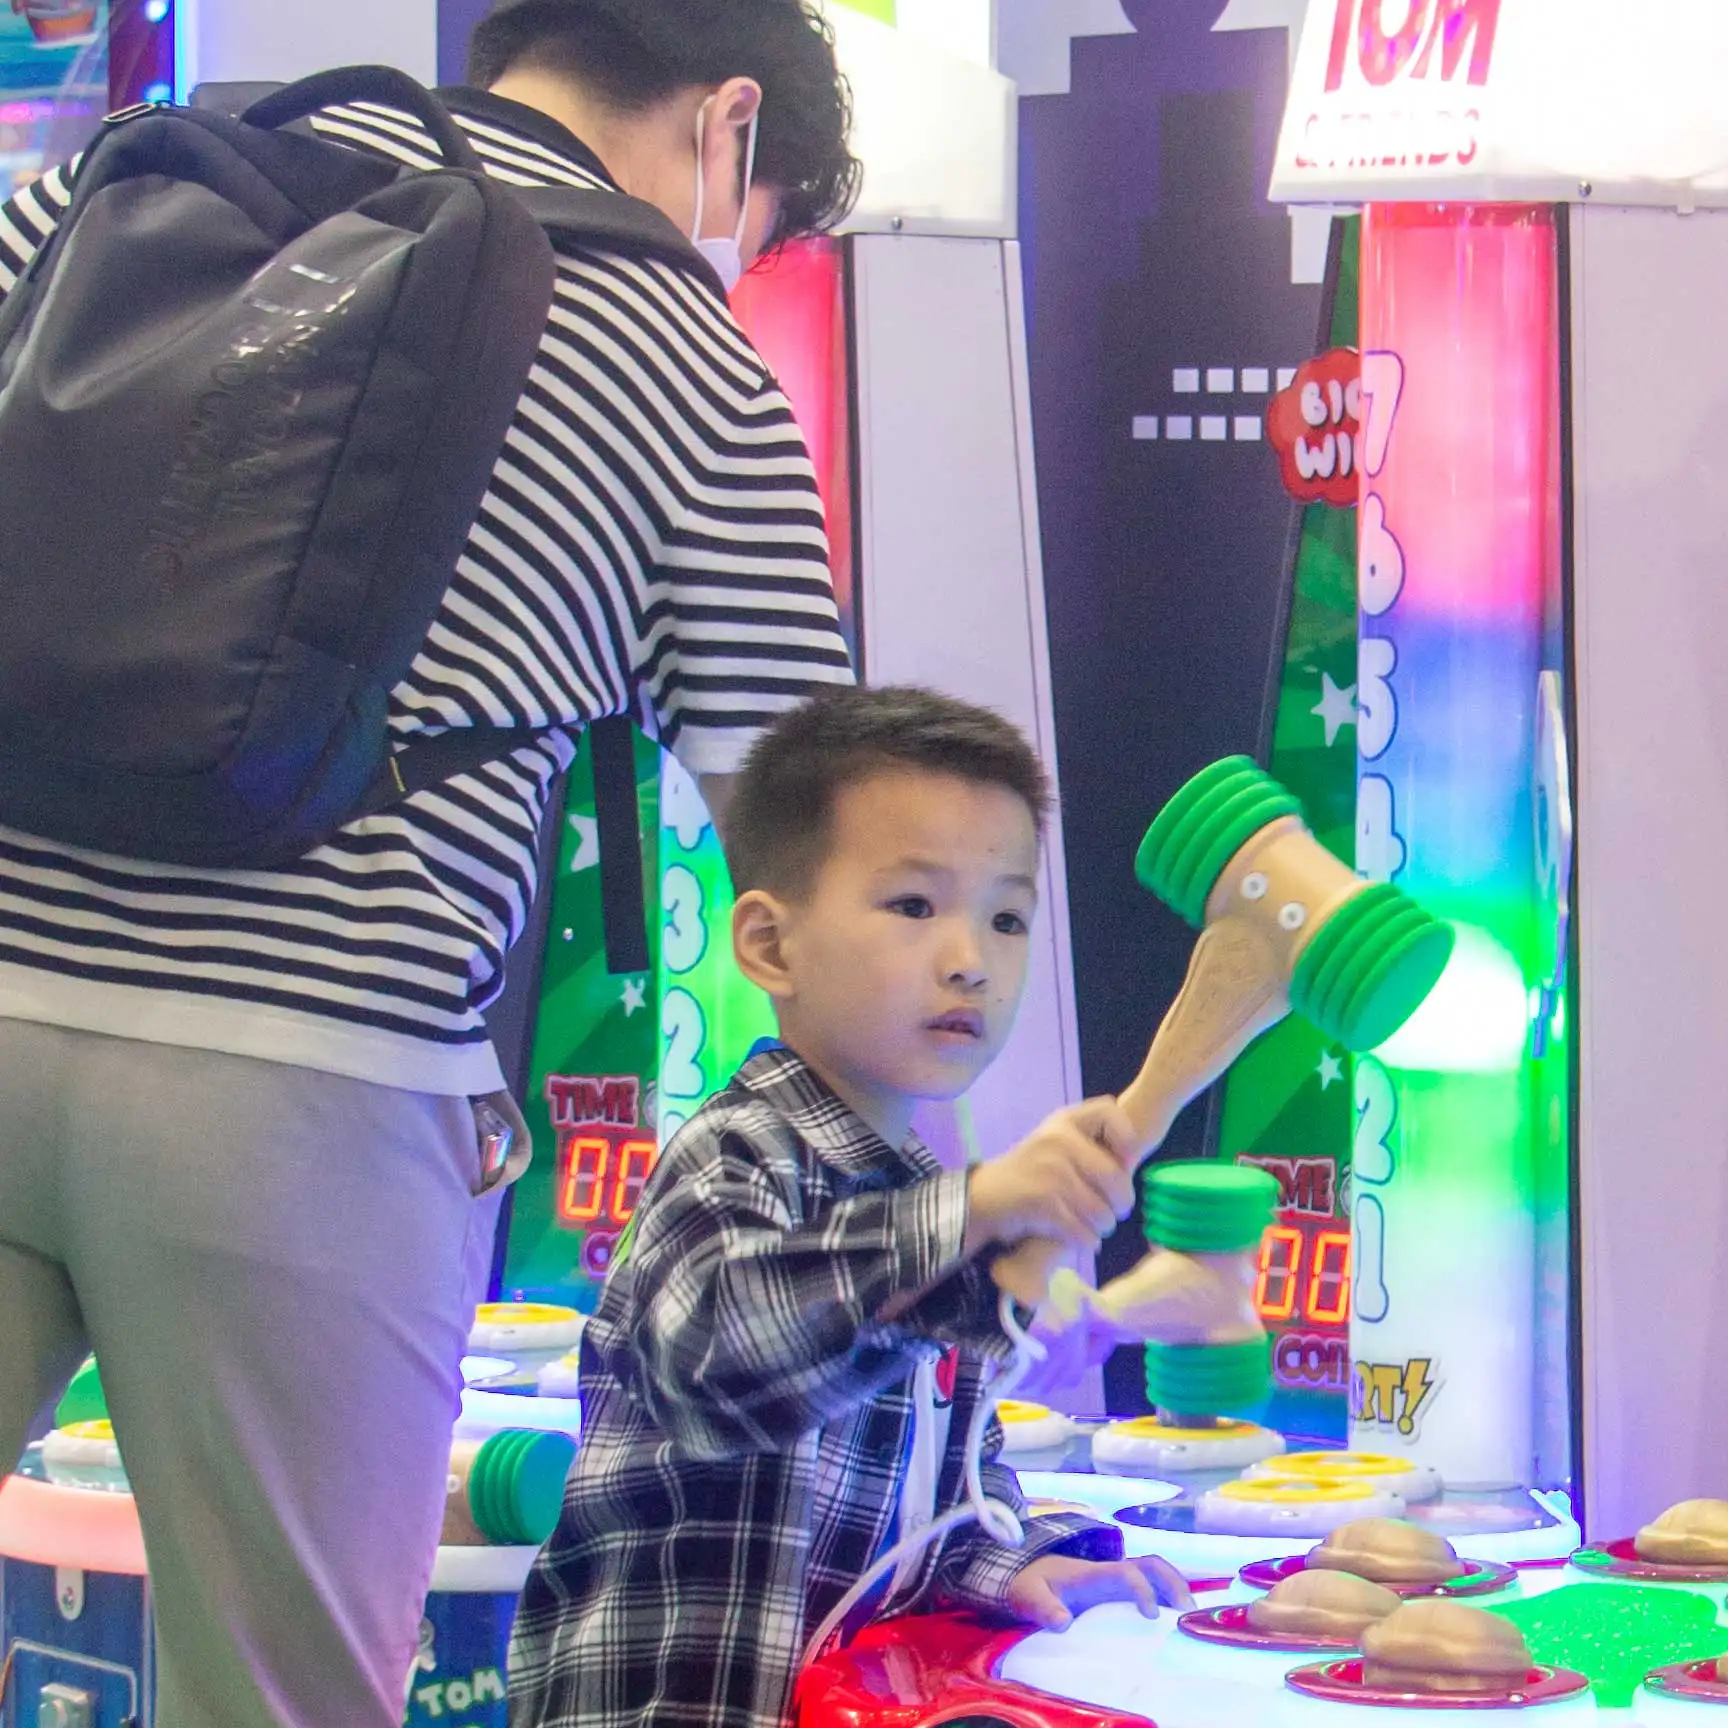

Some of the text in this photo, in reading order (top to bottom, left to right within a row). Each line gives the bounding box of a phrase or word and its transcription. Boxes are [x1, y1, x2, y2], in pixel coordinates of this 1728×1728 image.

[1294, 431, 1361, 479] WI
[1361, 349, 1404, 478] 7
[662, 862, 709, 975] 3
[661, 985, 707, 1099] 2
[547, 1077, 638, 1128] TIME
[1354, 1053, 1398, 1185] 2
[416, 1669, 506, 1717] TOM
